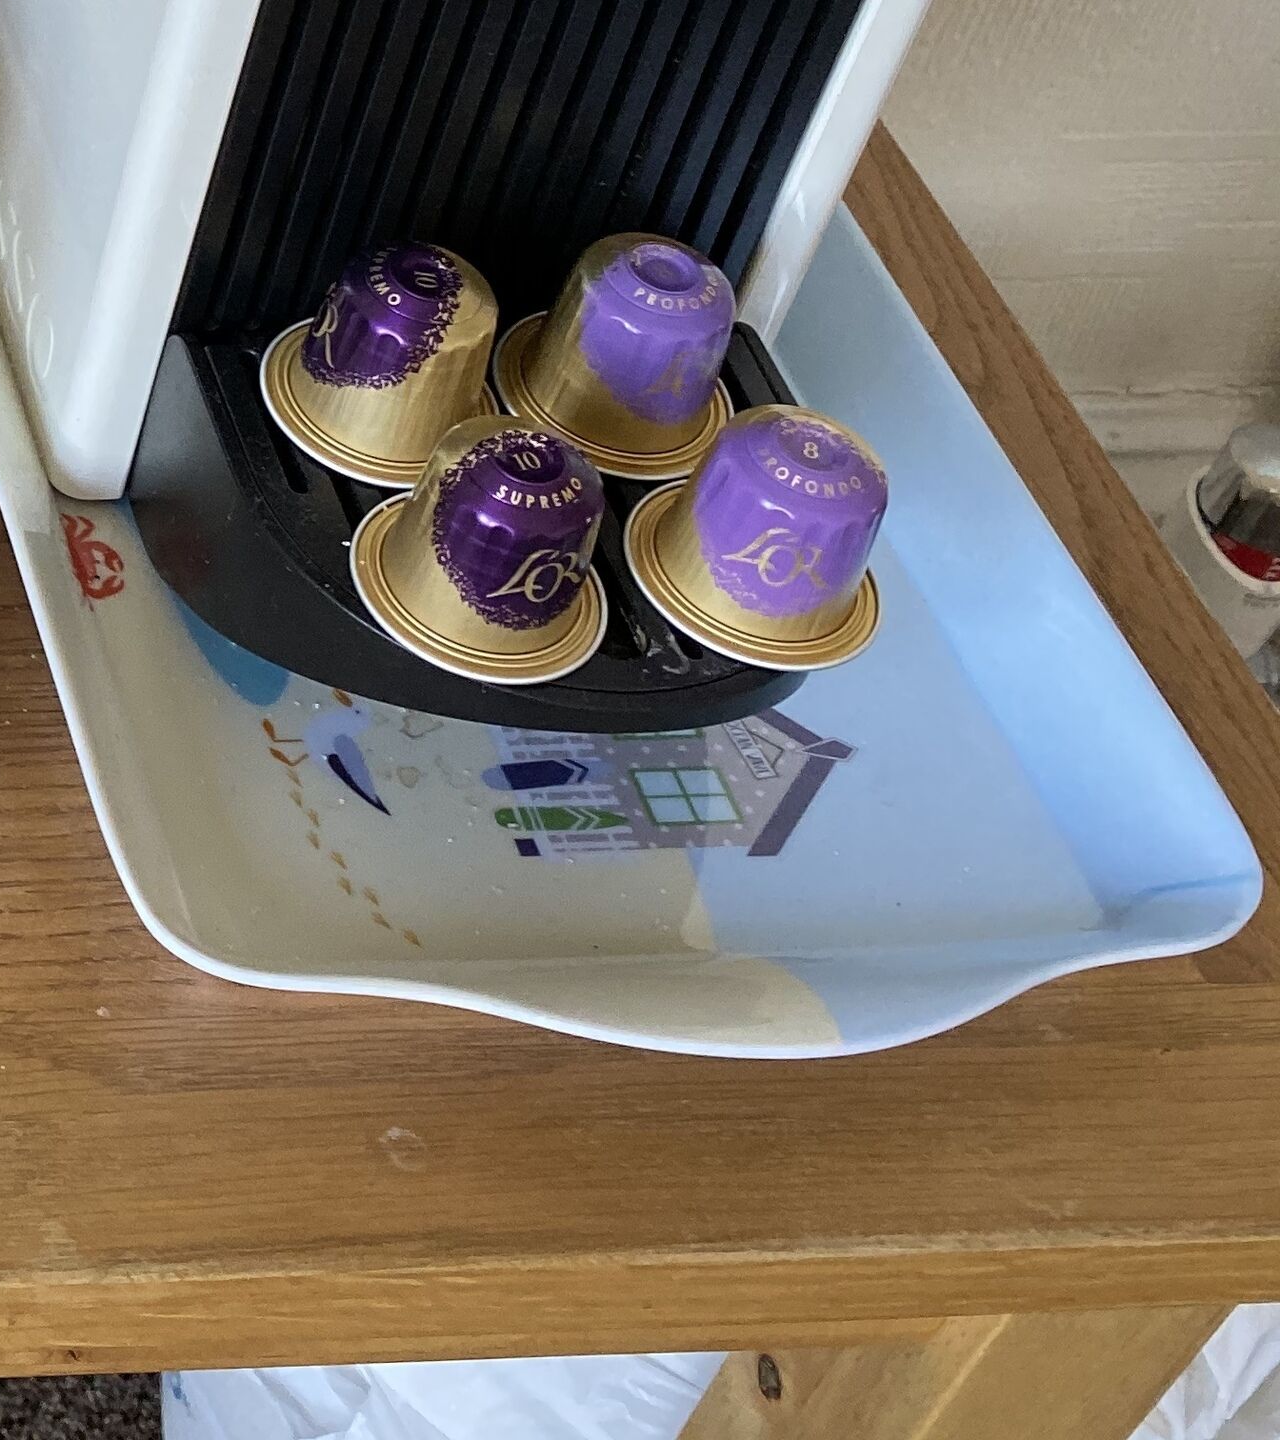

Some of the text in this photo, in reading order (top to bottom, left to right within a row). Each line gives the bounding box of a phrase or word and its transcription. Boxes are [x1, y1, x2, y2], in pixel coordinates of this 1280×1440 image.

[414, 269, 440, 289] 10
[803, 441, 819, 459] 8
[513, 450, 541, 471] 10
[495, 476, 583, 509] SUPREMO
